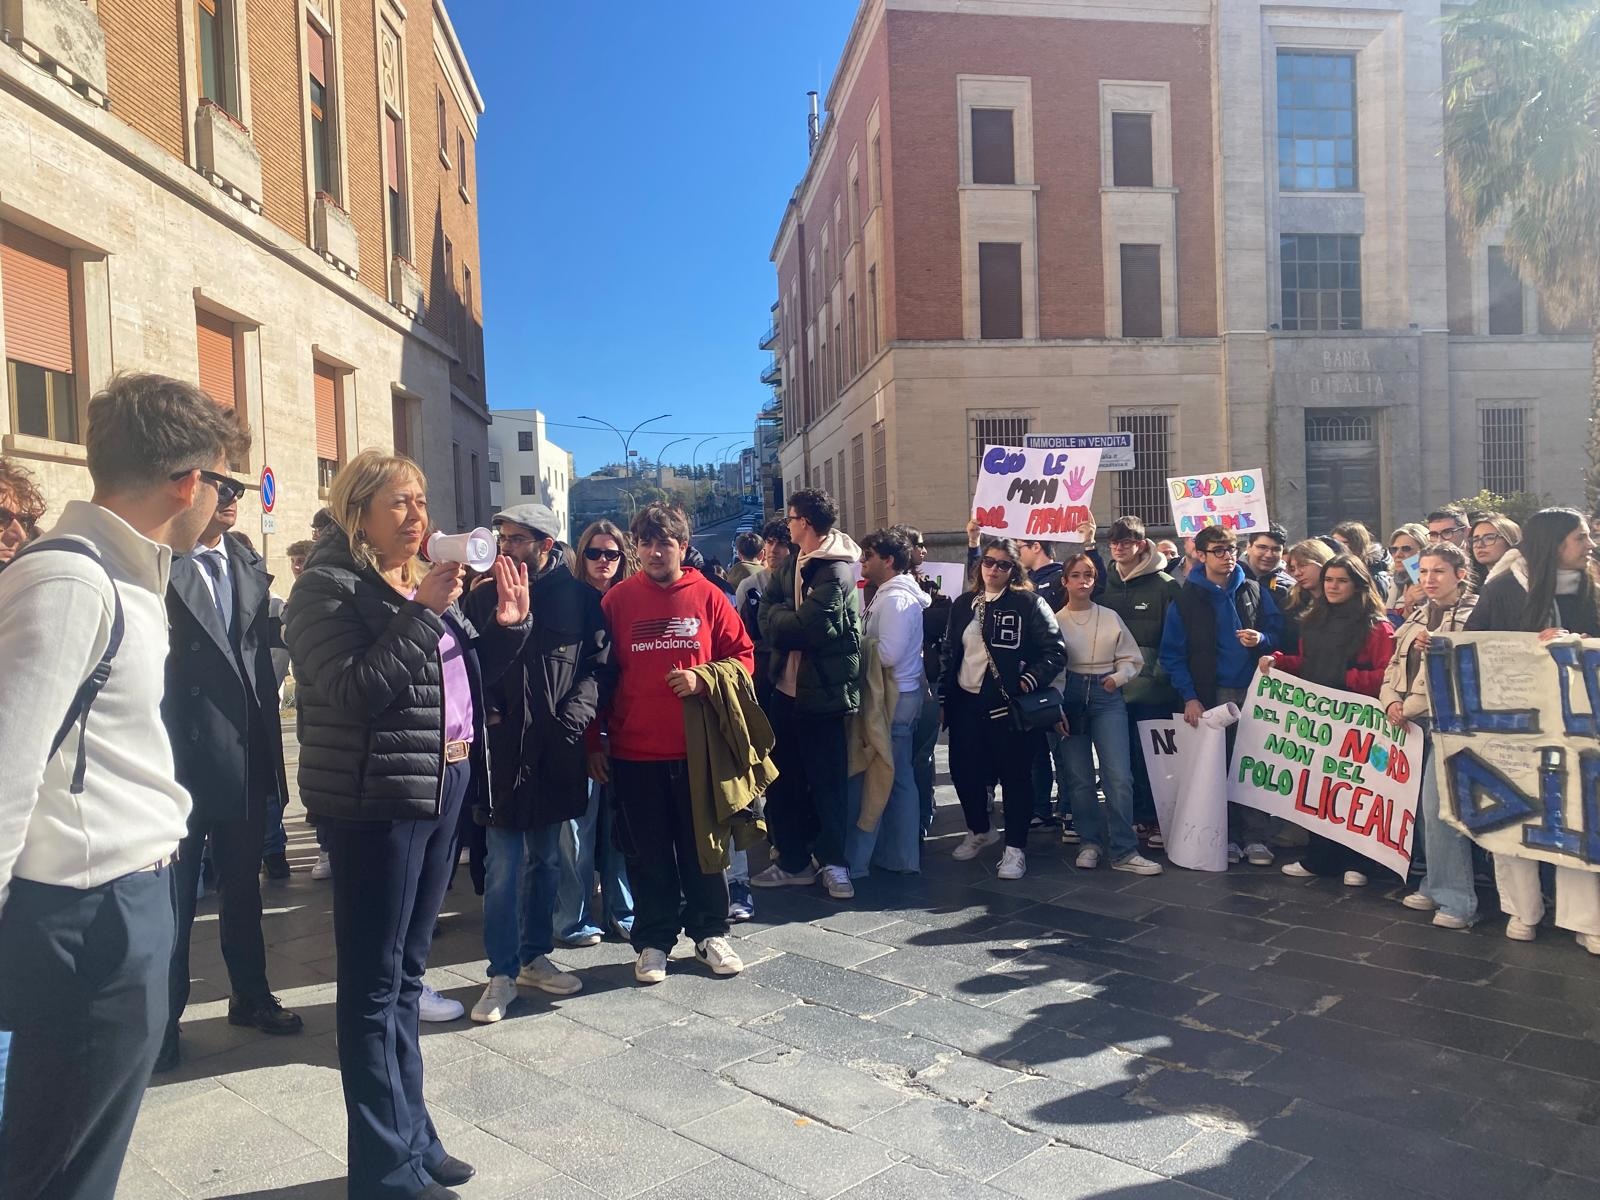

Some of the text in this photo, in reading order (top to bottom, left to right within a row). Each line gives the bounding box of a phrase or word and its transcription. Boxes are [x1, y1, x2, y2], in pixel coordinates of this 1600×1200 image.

[1323, 350, 1371, 368] BANCA
[1029, 436, 1127, 448] IMMOBILE IN VENDITA
[1043, 452, 1068, 476] LE
[1006, 477, 1059, 505] MANI
[976, 505, 1009, 529] DAL
[631, 638, 700, 652] new balance
[1257, 675, 1407, 746] PREOCCUPATEVI
[1253, 705, 1410, 784] DEL POLO NORD
[1264, 734, 1365, 784] NON DEL
[1239, 756, 1415, 862] POLO LICEALE
